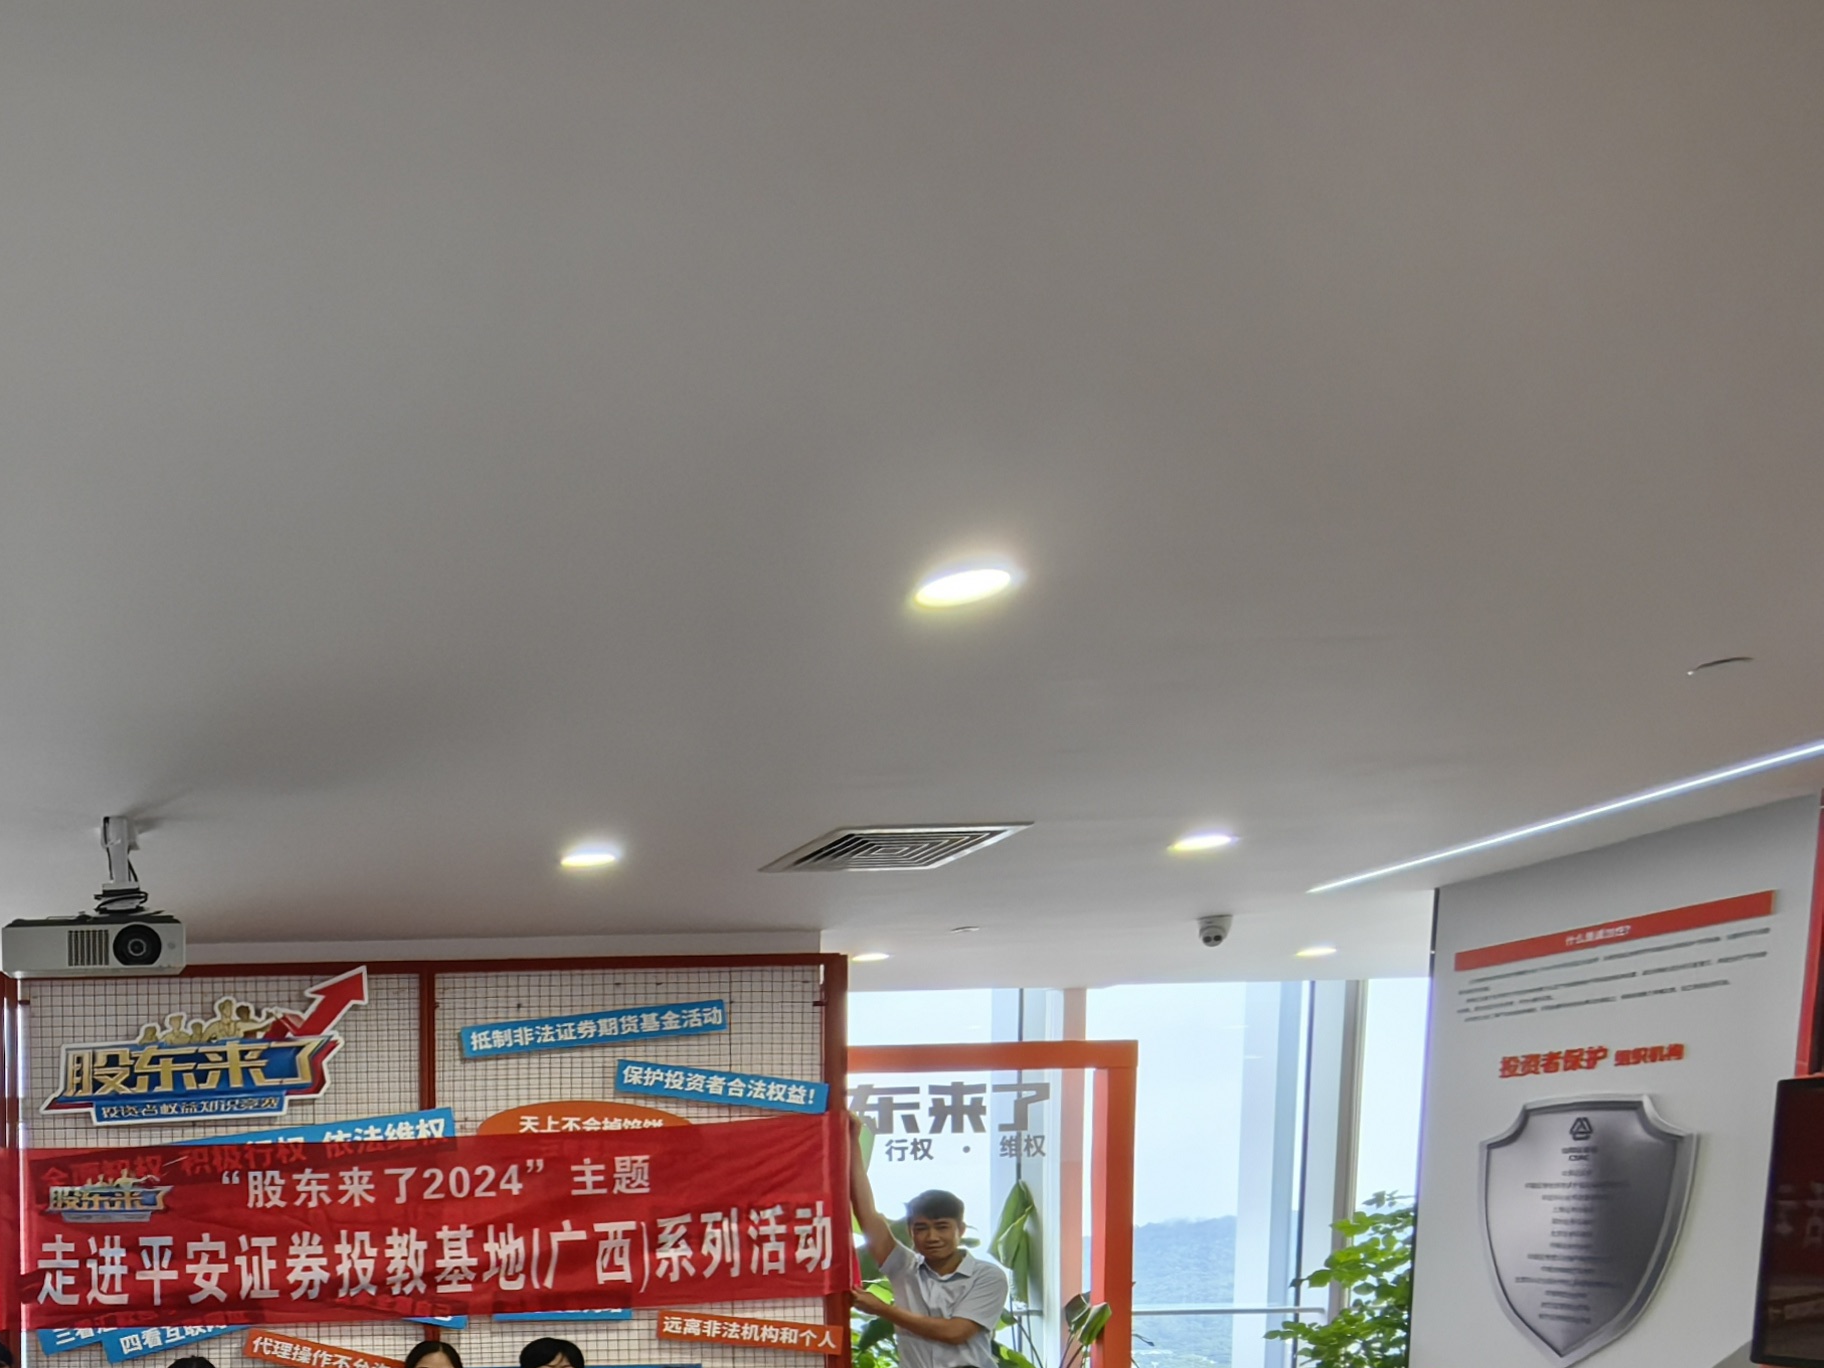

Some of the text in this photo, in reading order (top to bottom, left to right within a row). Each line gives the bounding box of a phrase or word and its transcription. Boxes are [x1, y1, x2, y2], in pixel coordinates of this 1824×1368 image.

[470, 1006, 723, 1052] 抵制非法证券期货基金活动
[64, 1037, 324, 1097] 股东来了
[1499, 1045, 1609, 1078] 投资者保护
[622, 1065, 816, 1106] 保护投资者合法权益!
[101, 1096, 281, 1119] 投资者权益知识竞赛
[885, 1134, 1046, 1162] 行权 维权
[221, 1155, 651, 1209] “股东来了2024” 主题
[37, 1201, 833, 1307] 走进平安证券投教基地(广西)系列活动
[663, 1316, 837, 1350] 远离非法机构和个人
